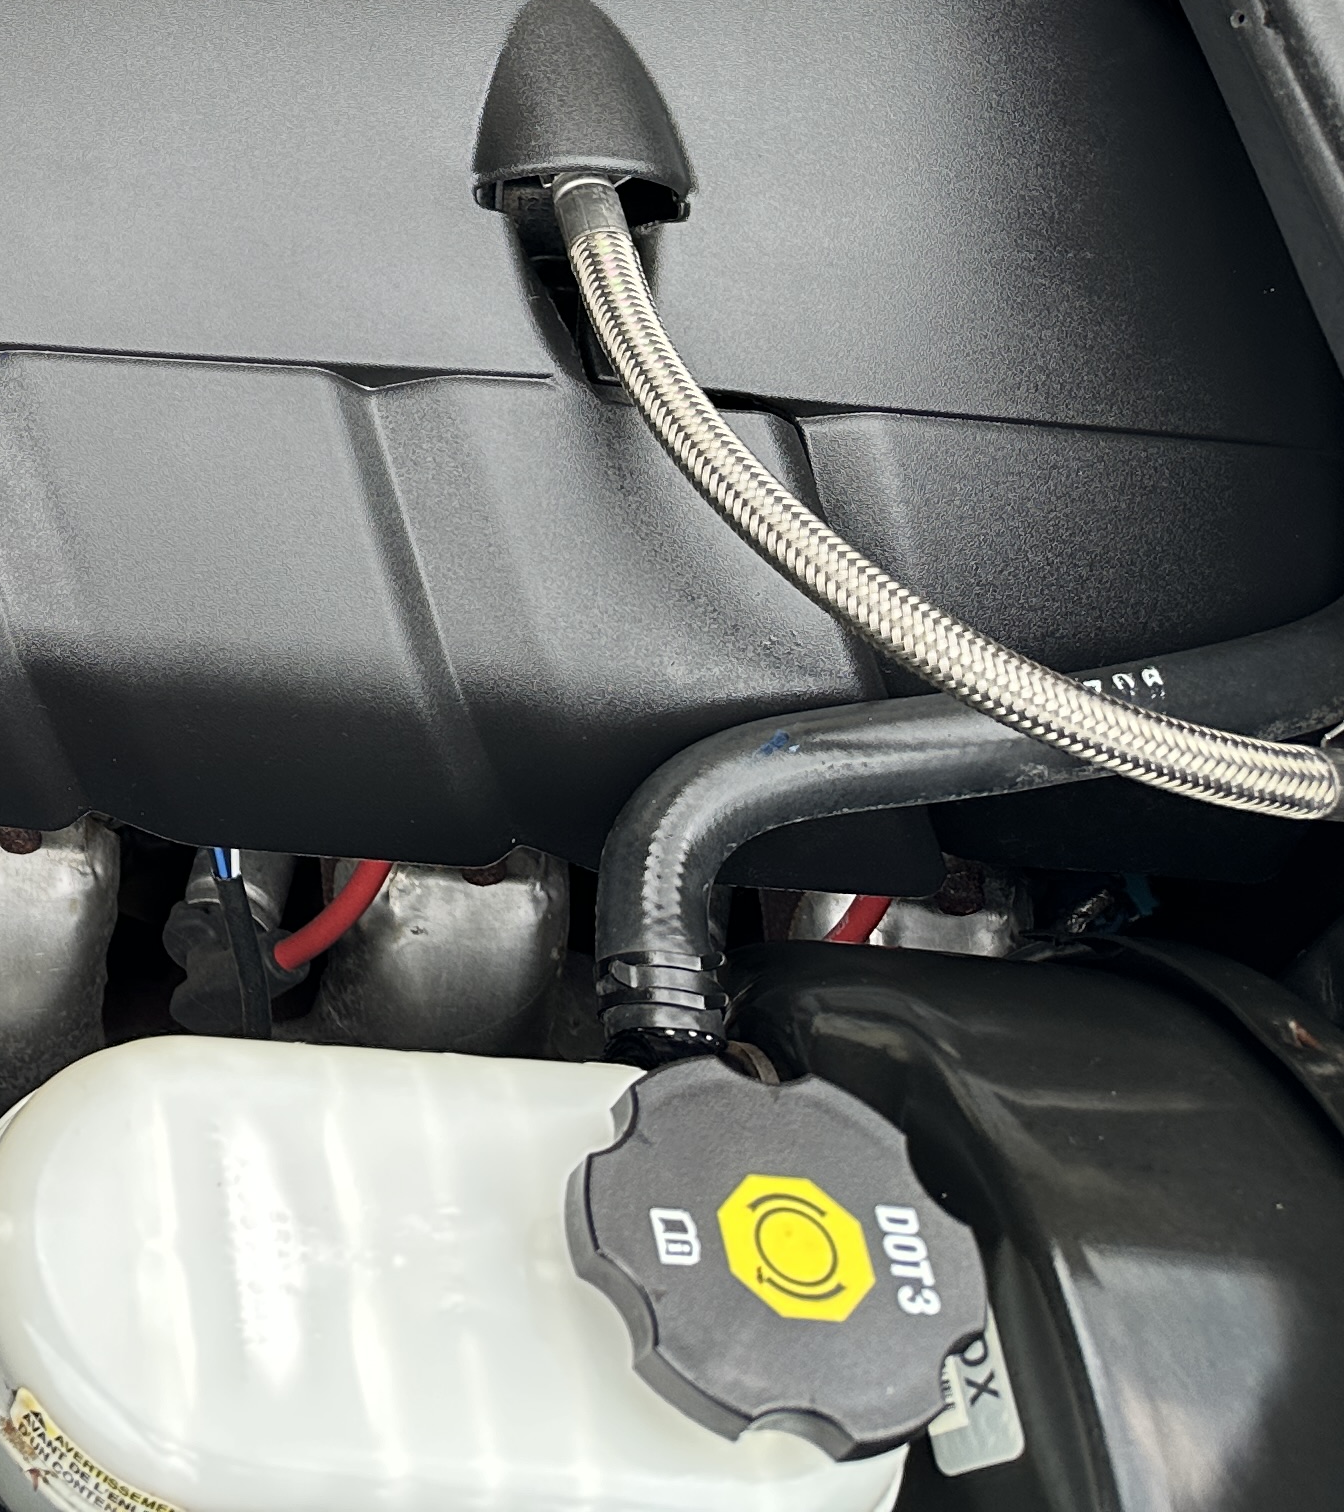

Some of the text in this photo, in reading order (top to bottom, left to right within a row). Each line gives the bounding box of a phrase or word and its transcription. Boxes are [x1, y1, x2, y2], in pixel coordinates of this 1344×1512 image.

[875, 1204, 942, 1316] DOT 3
[55, 1435, 176, 1512] AVERTISSEME
[69, 1461, 91, 1484] DE
